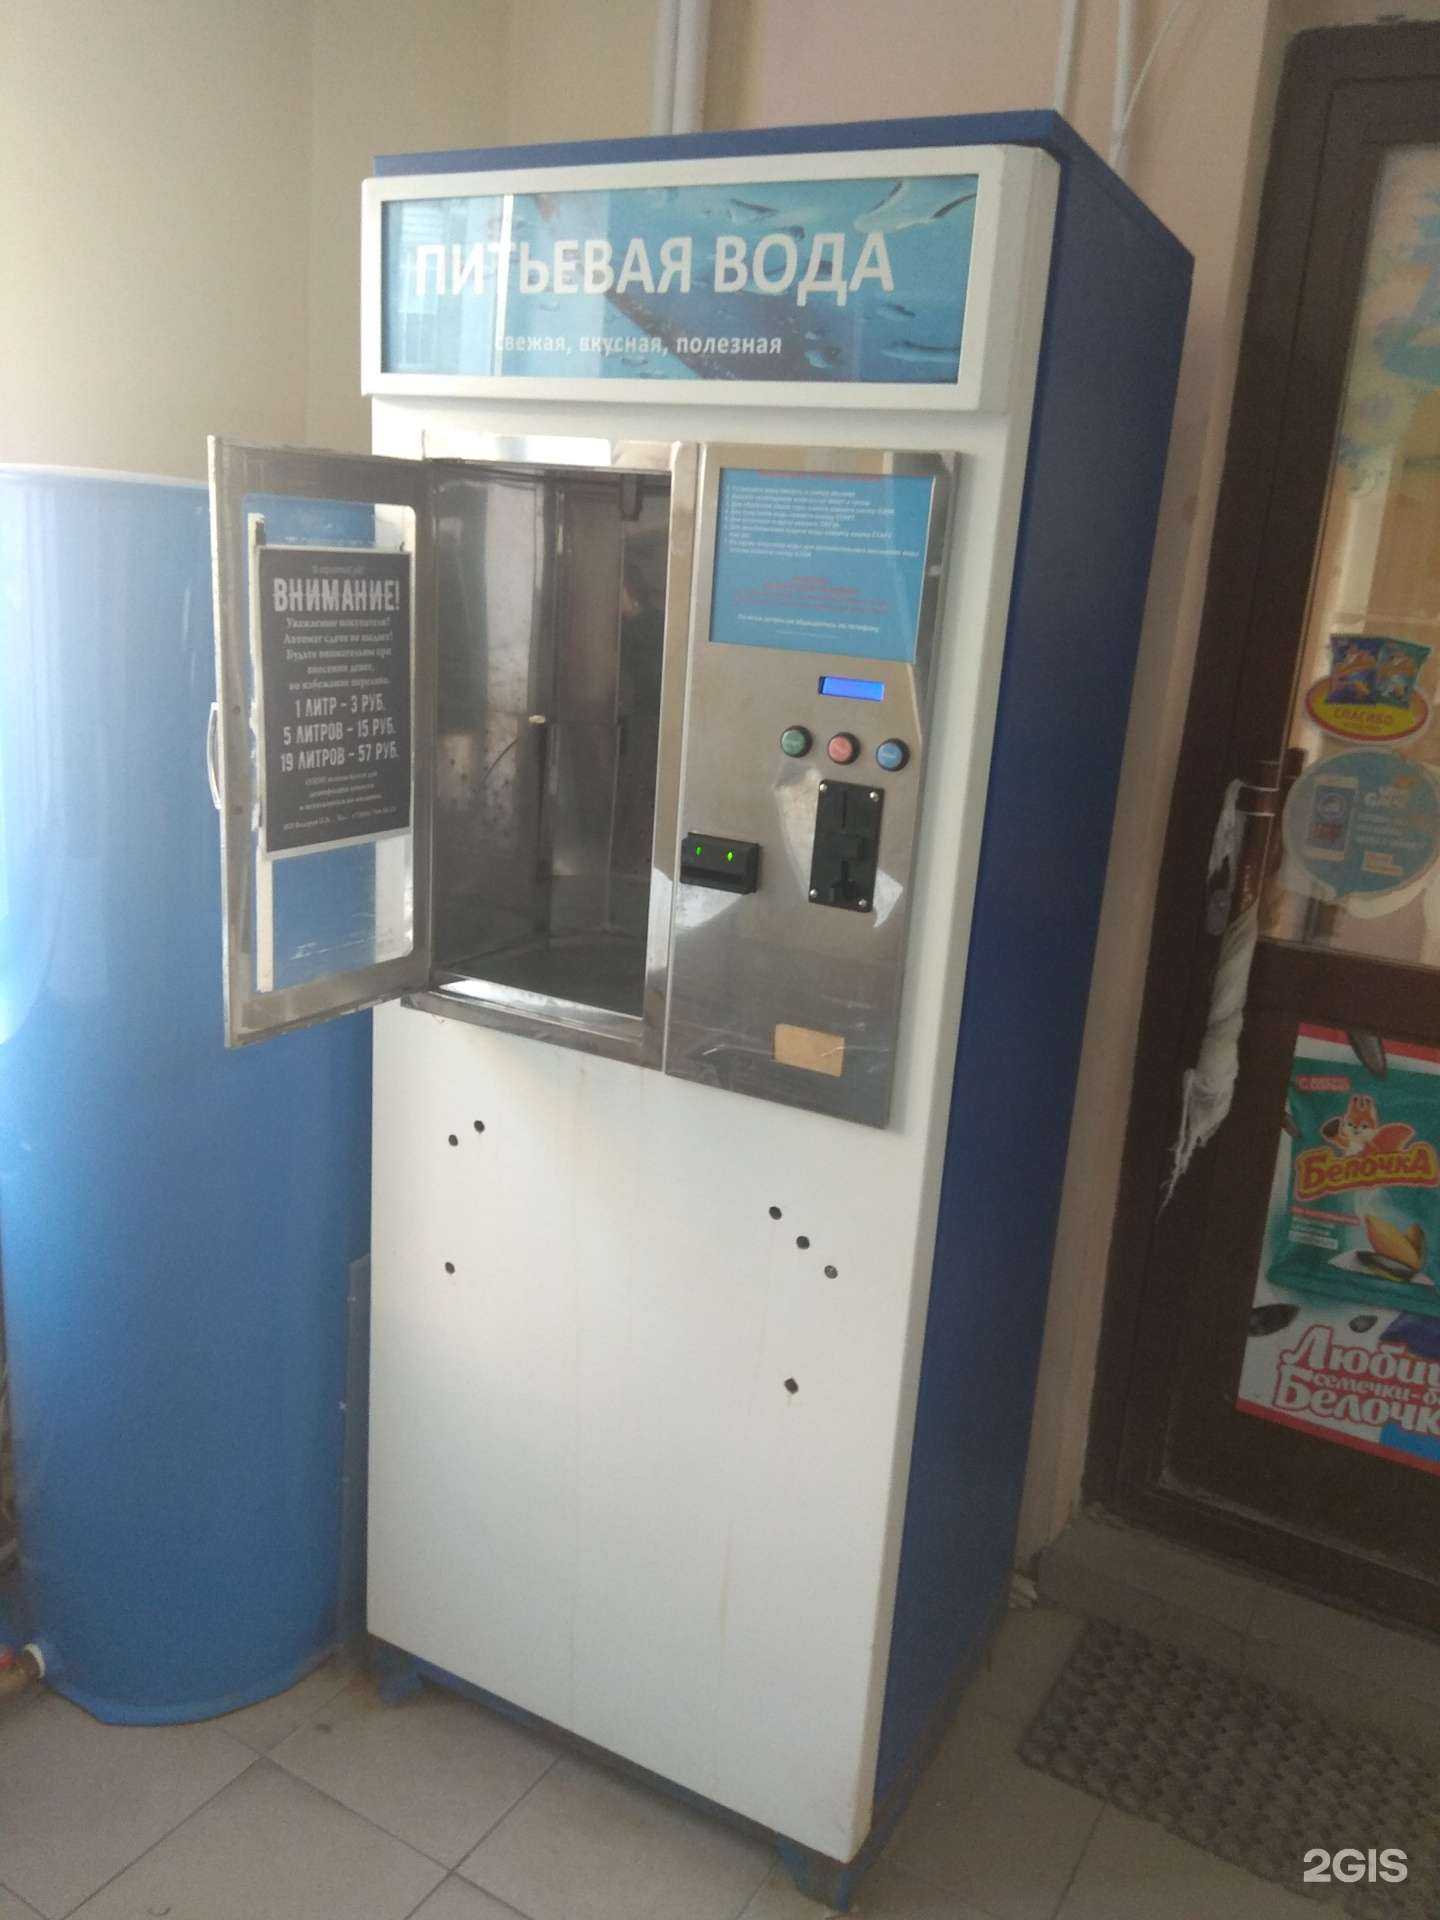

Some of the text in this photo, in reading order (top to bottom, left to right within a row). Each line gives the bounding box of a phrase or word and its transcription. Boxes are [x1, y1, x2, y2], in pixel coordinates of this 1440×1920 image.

[415, 230, 895, 307] ПИТЬЕВАЯ ВОДА
[579, 335, 669, 359] вкусная,
[676, 335, 782, 355] полезная
[272, 577, 400, 612] ВНИМАНИЕ!
[295, 700, 301, 718] 1
[305, 697, 337, 717] ЛИТР
[350, 695, 358, 713] 3
[361, 693, 386, 712] РУБ.
[283, 726, 291, 745] 5
[295, 721, 344, 745] ЛИТРОВ
[357, 719, 369, 738] 15
[372, 717, 396, 736] РУБ.
[280, 752, 294, 772] 19
[297, 746, 345, 770] ЛИТРОВ
[358, 744, 372, 763] 57
[375, 741, 400, 760] РУБ.
